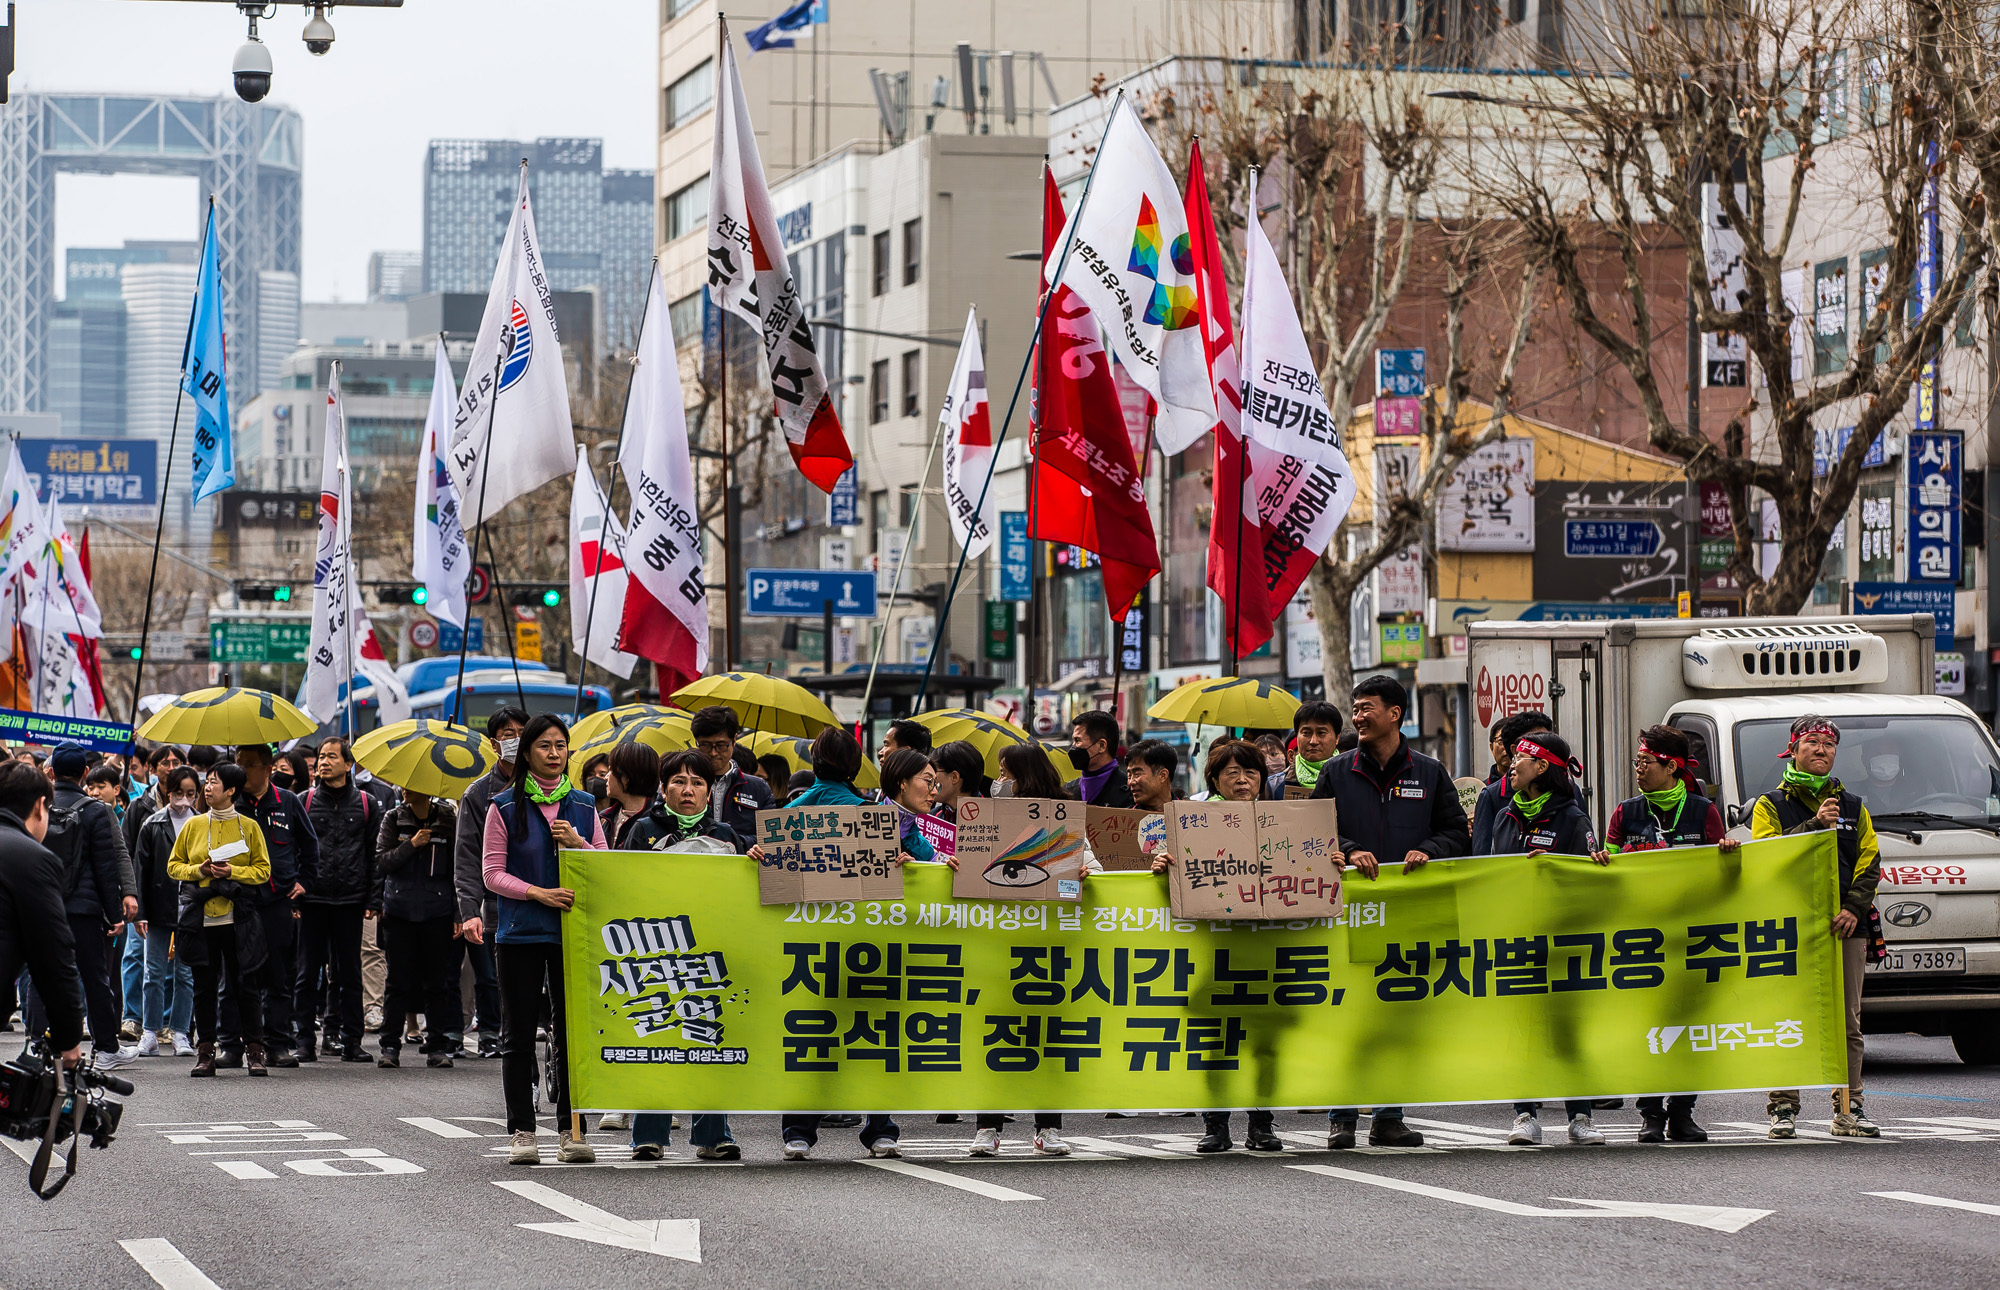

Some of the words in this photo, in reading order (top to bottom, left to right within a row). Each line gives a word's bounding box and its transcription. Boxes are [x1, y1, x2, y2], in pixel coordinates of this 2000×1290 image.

[1071, 238, 1160, 372] 학섬유식품산업노
[1713, 363, 1740, 385] 4F
[638, 470, 704, 556] 학섬유식
[1571, 523, 1628, 541] 종로31길
[1007, 525, 1027, 584] 노래방
[416, 627, 433, 641] 50
[1783, 639, 1850, 651] HYUNDAI
[1521, 741, 1540, 756] 투쟁
[925, 821, 955, 843] 안전하게
[958, 823, 1000, 834] #여성참정권
[1179, 812, 1209, 830] 말뿐인
[1221, 812, 1243, 828] 평등
[1258, 813, 1279, 829] 말고
[957, 845, 991, 854] #WOMEN
[1260, 834, 1294, 862] 진짜
[1298, 836, 1337, 860] 평등!
[761, 843, 842, 874] 여성노동권
[839, 846, 899, 880] 보장하라
[1183, 852, 1274, 890] 불편해야
[1878, 865, 1968, 885] 서울우유
[785, 902, 856, 926] 2023
[866, 902, 907, 926] 3.8
[915, 903, 1048, 931] 세계여성의
[1057, 905, 1082, 931] 날
[601, 914, 698, 957] 이미
[782, 942, 980, 1006] 저임금,
[1010, 946, 1195, 1008] 장시간
[1213, 943, 1346, 1008] 노동,
[1374, 927, 1666, 1003] 성차별고용
[1686, 917, 1799, 985] 주범
[1912, 950, 1956, 969] 9389
[598, 950, 734, 998] 시작된
[782, 1009, 962, 1073] 윤석열
[983, 1014, 1102, 1073] 정부
[1124, 1014, 1246, 1072] 규탄
[1690, 1018, 1803, 1053] 민주노총
[603, 1049, 649, 1062] 투쟁으로
[651, 1049, 685, 1063] 나서는
[688, 1049, 747, 1064] 여성노동자
